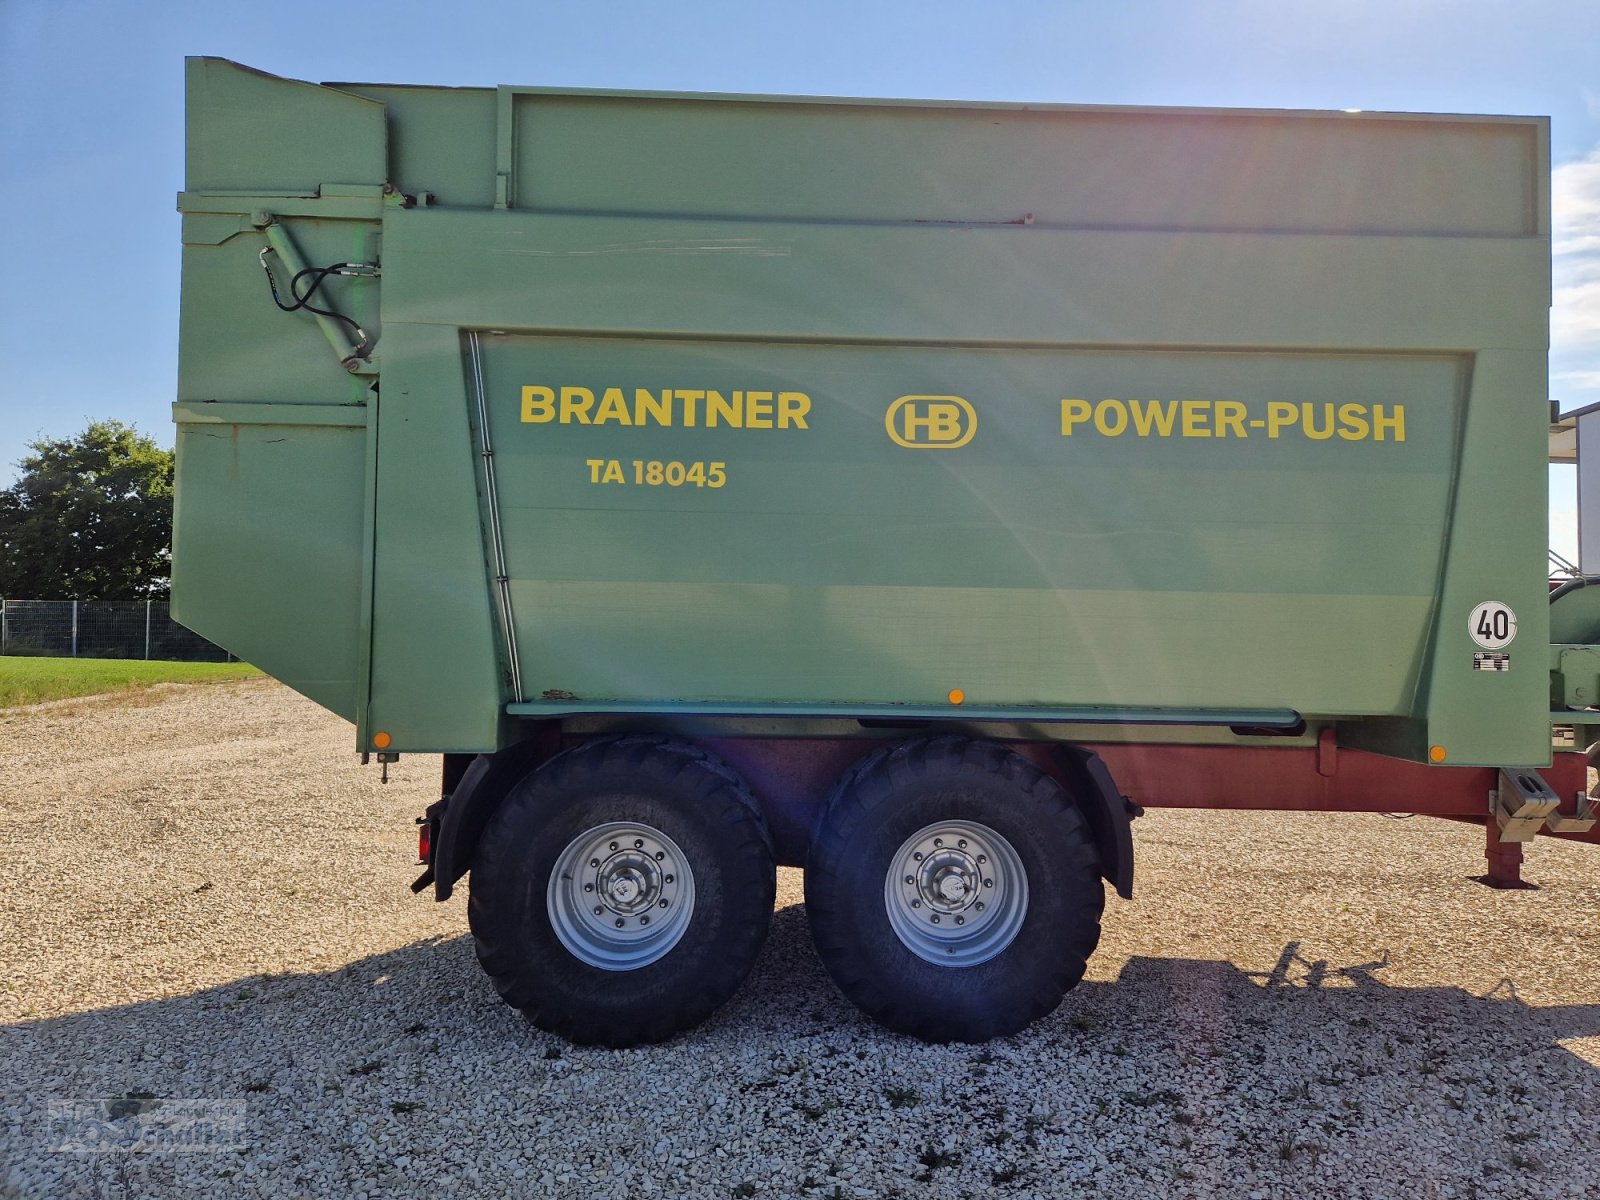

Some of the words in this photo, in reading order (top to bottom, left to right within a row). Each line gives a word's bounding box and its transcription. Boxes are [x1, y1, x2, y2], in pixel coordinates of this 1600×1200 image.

[520, 385, 811, 429] BRANTNER
[904, 404, 961, 441] HB
[1061, 399, 1406, 442] POWER-PUSH
[586, 460, 625, 485] TA
[633, 461, 727, 488] 18045
[1477, 610, 1508, 640] 40
